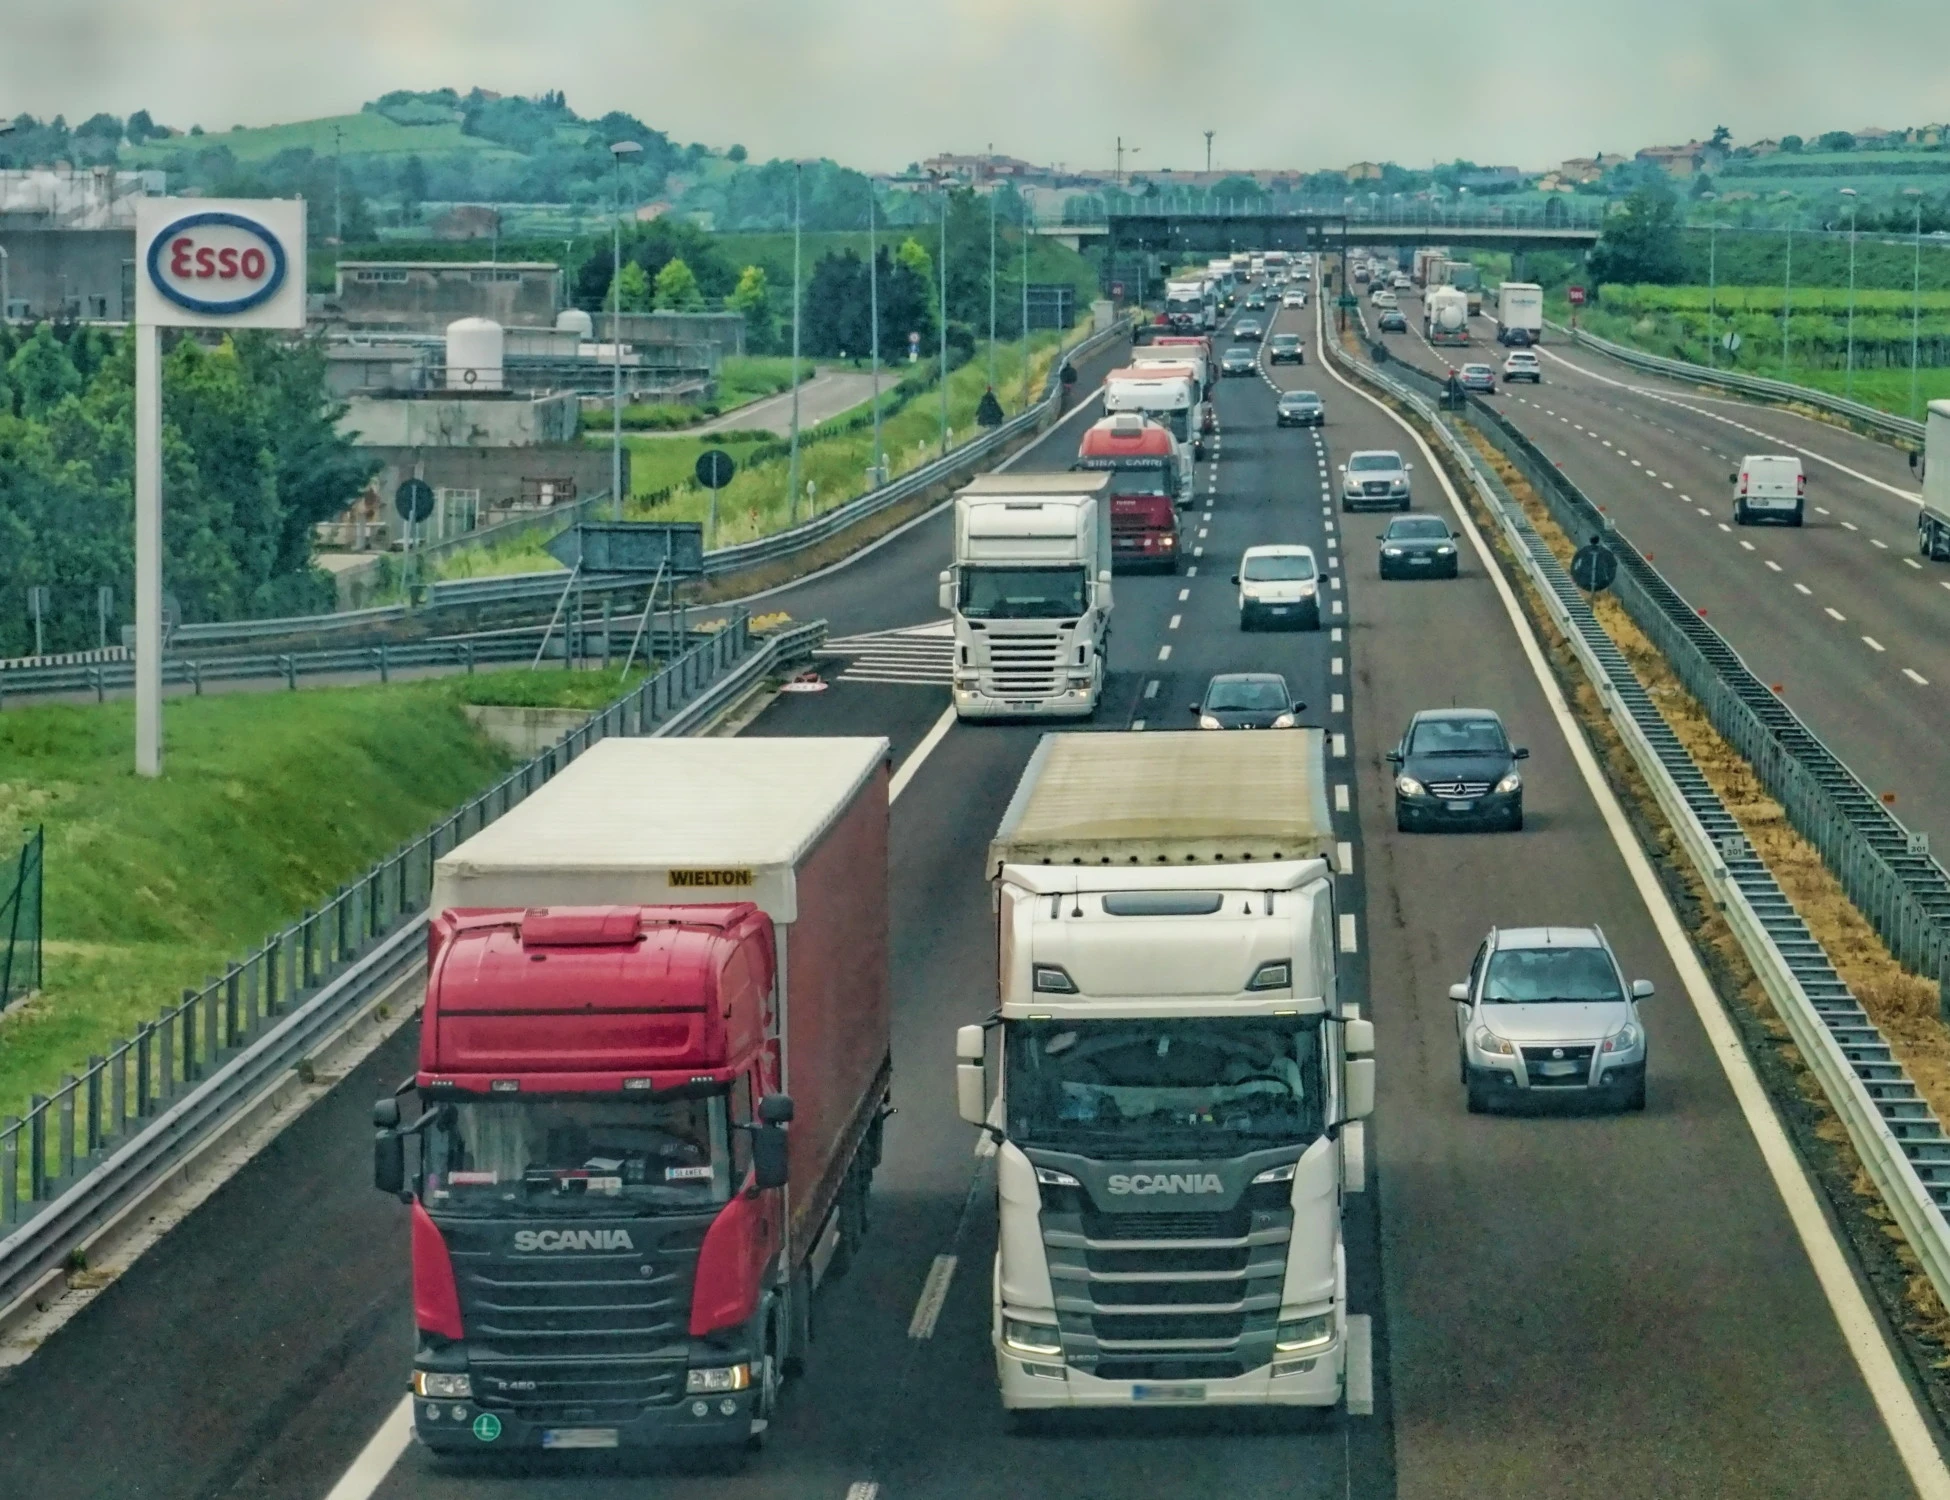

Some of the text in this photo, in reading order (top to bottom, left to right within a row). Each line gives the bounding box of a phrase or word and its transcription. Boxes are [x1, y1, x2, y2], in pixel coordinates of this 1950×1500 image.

[670, 869, 749, 886] WIELTON
[1107, 1173, 1225, 1195] SCANIA
[514, 1229, 634, 1251] SCANIA
[481, 1416, 495, 1436] L
